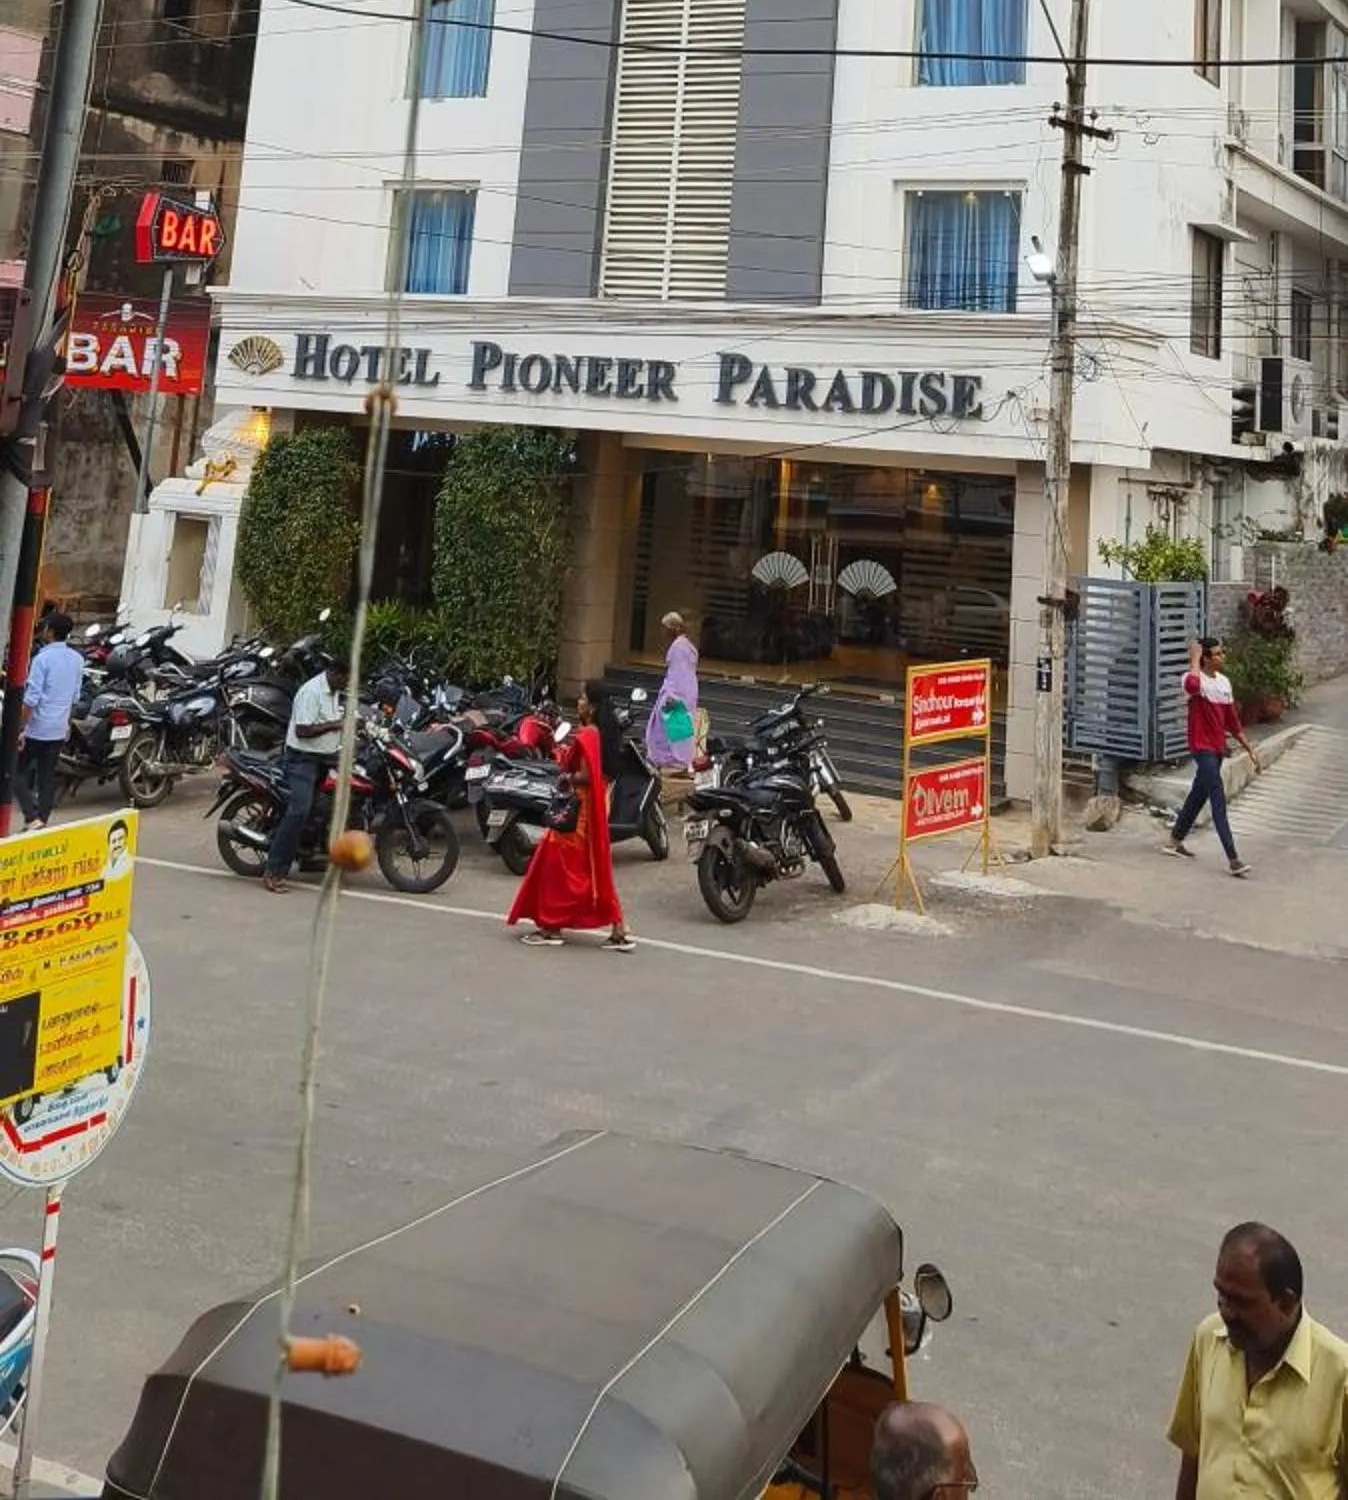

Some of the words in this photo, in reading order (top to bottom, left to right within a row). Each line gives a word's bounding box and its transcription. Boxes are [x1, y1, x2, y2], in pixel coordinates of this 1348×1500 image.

[162, 211, 217, 255] BAR
[66, 332, 181, 378] BAR
[290, 333, 440, 387] HOTEL
[467, 340, 681, 401] PIONEER
[712, 351, 983, 421] PARADISE
